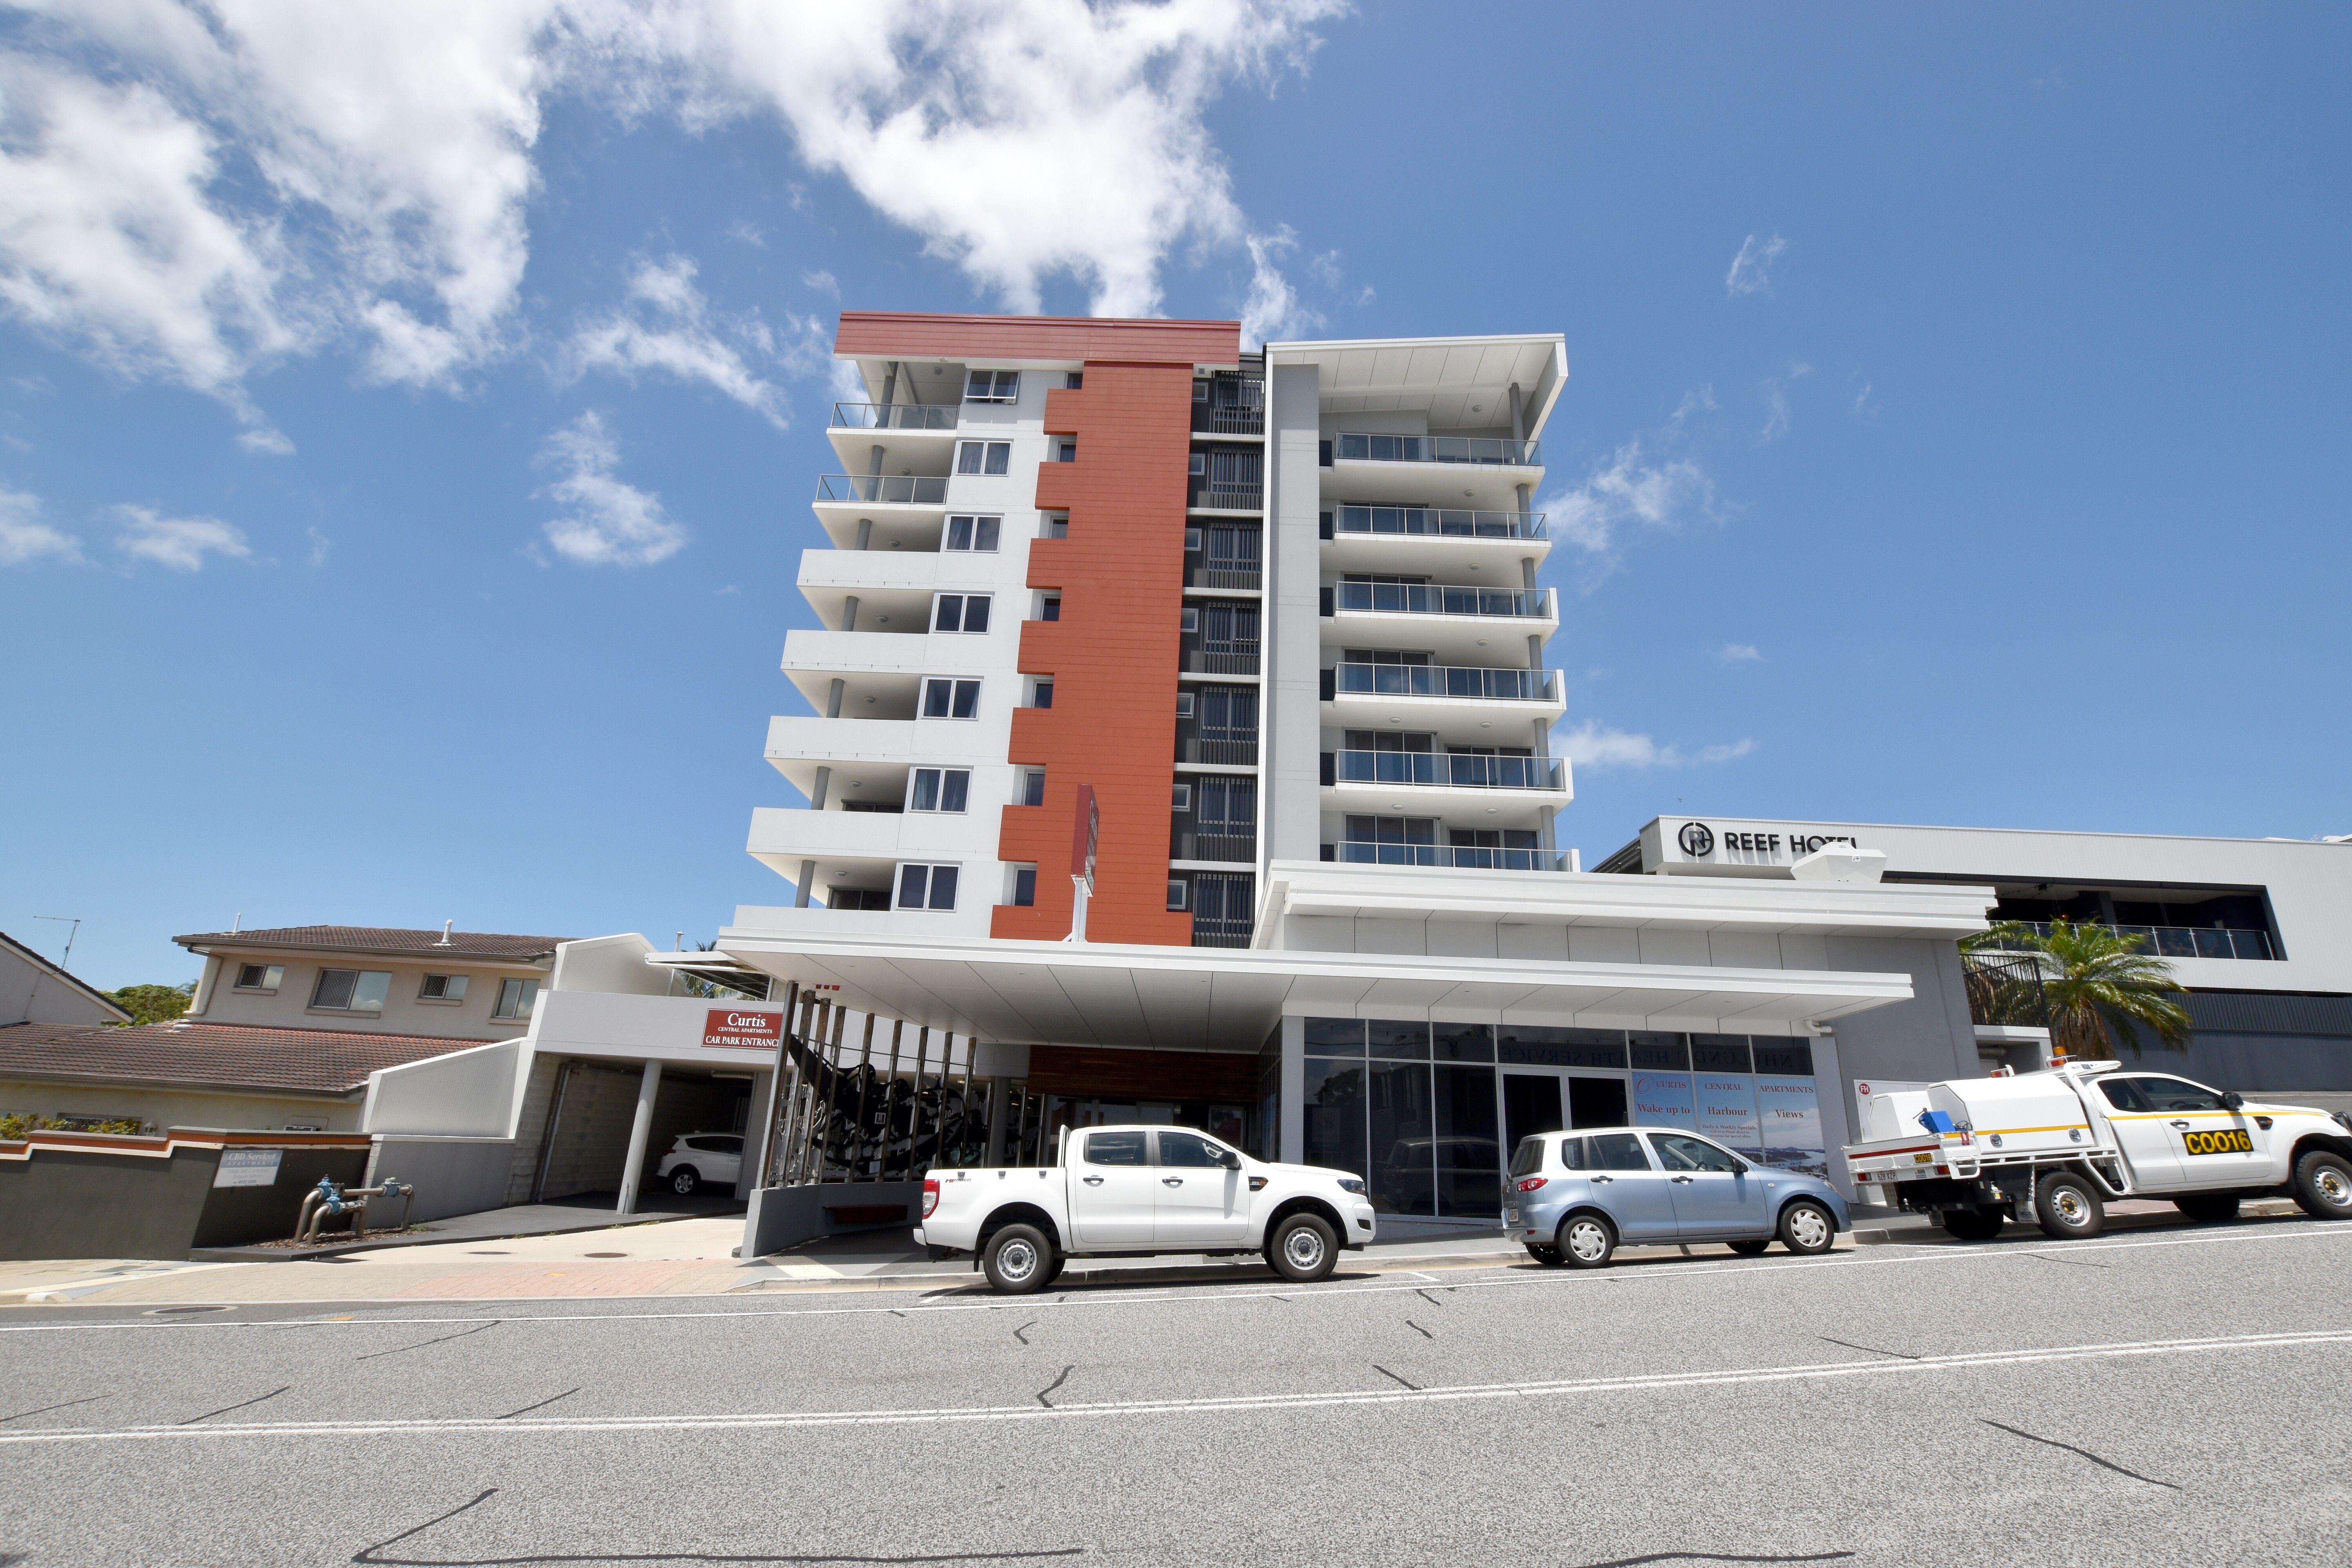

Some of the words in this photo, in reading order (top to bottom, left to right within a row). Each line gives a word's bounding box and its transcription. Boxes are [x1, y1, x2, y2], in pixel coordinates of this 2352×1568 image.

[1724, 832, 1780, 851] REEF
[728, 1013, 766, 1027] Curtis
[722, 1036, 740, 1045] PARK
[1638, 1103, 1663, 1112] Wake
[1708, 1107, 1748, 1116] Harbour
[1775, 1109, 1804, 1118] Views
